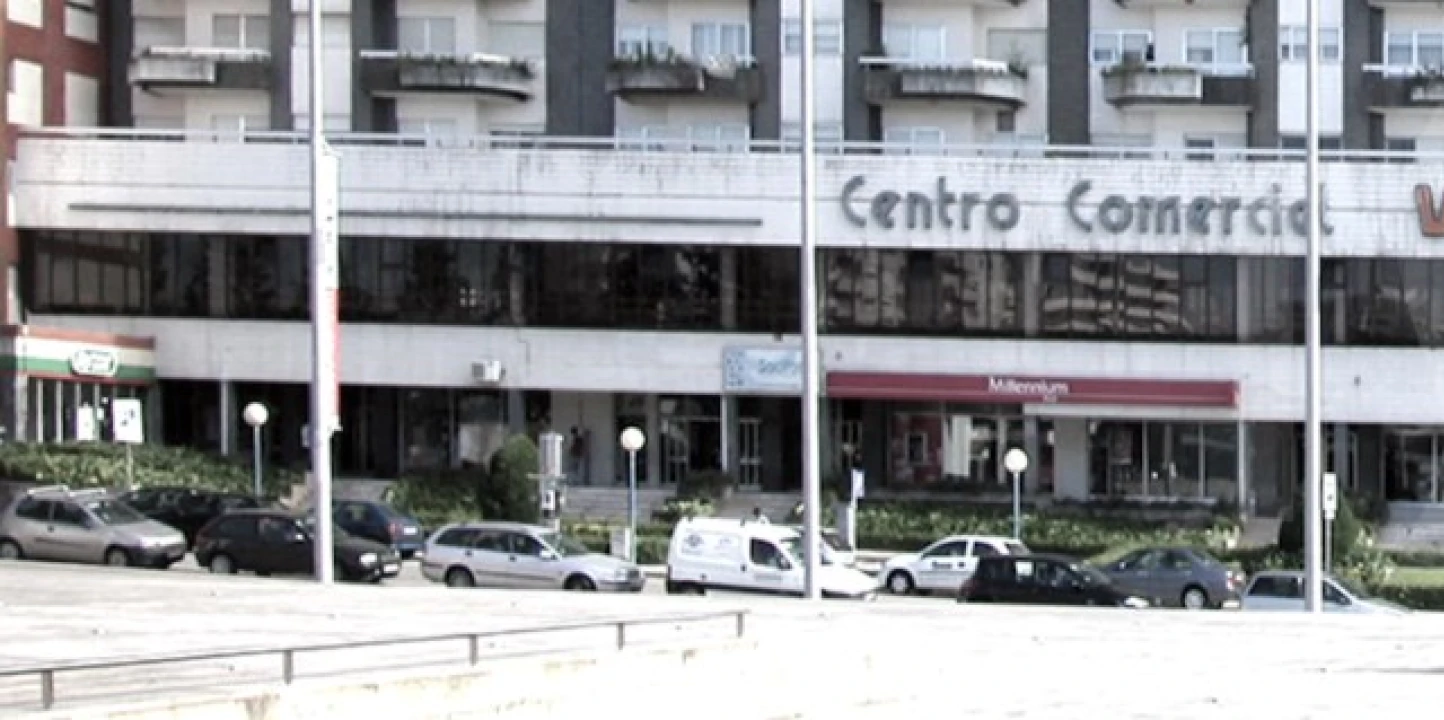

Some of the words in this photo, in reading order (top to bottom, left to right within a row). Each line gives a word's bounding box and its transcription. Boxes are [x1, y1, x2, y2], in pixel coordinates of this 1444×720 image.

[841, 175, 1021, 231] Centro
[1066, 179, 1335, 236] Comercial
[988, 376, 1068, 396] Millennium
